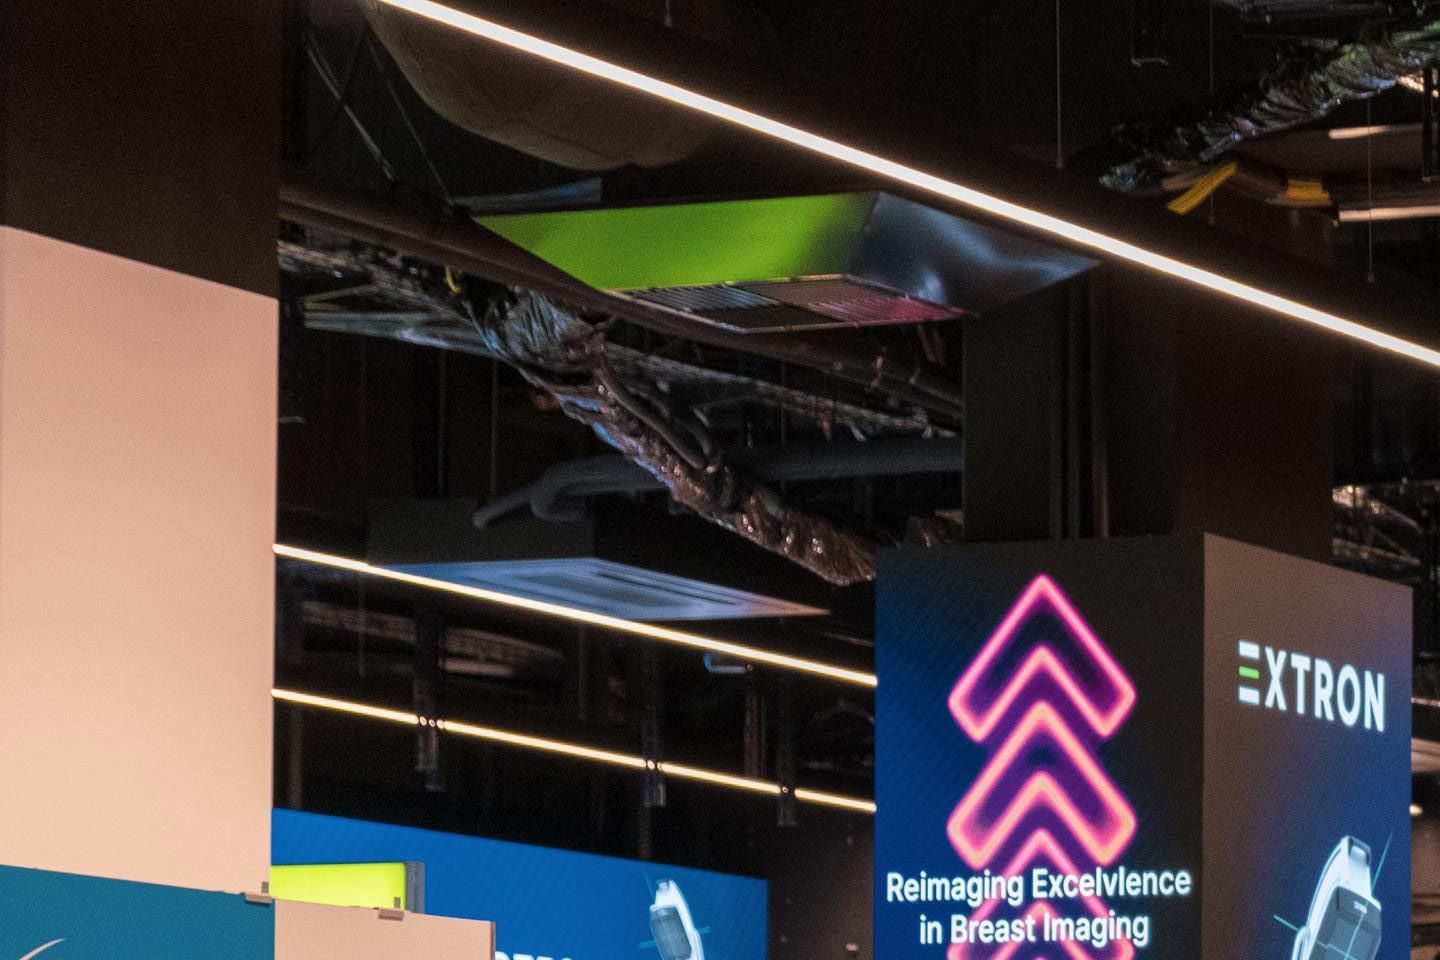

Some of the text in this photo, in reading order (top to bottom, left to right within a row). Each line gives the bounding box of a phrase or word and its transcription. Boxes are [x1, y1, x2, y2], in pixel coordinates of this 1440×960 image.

[1238, 639, 1385, 732] EXTRON
[886, 869, 1024, 907] Reimaging
[919, 910, 1150, 948] in Breast Imaging
